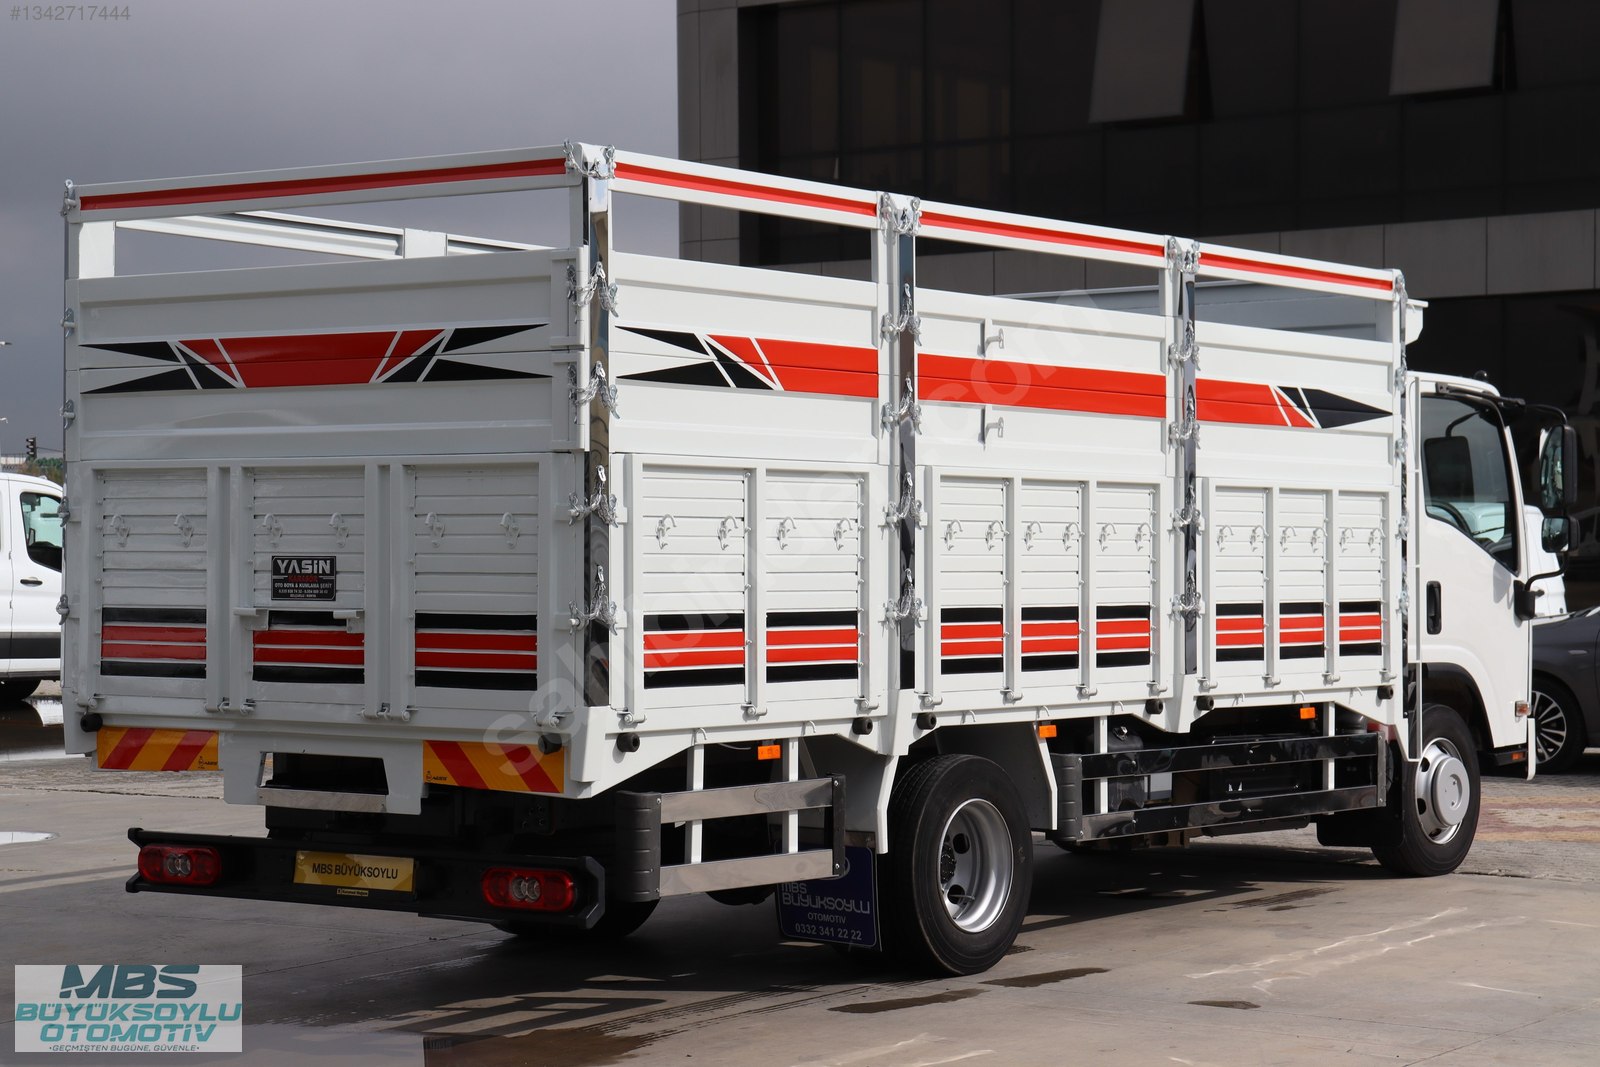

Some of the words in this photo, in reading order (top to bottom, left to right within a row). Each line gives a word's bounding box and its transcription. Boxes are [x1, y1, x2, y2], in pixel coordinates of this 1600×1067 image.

[312, 862, 333, 874] MBS
[334, 863, 398, 879] BÜYÜKSOYLU
[795, 923, 817, 935] 0332
[819, 925, 835, 937] 341
[837, 928, 849, 939] 22
[850, 929, 862, 941] 22
